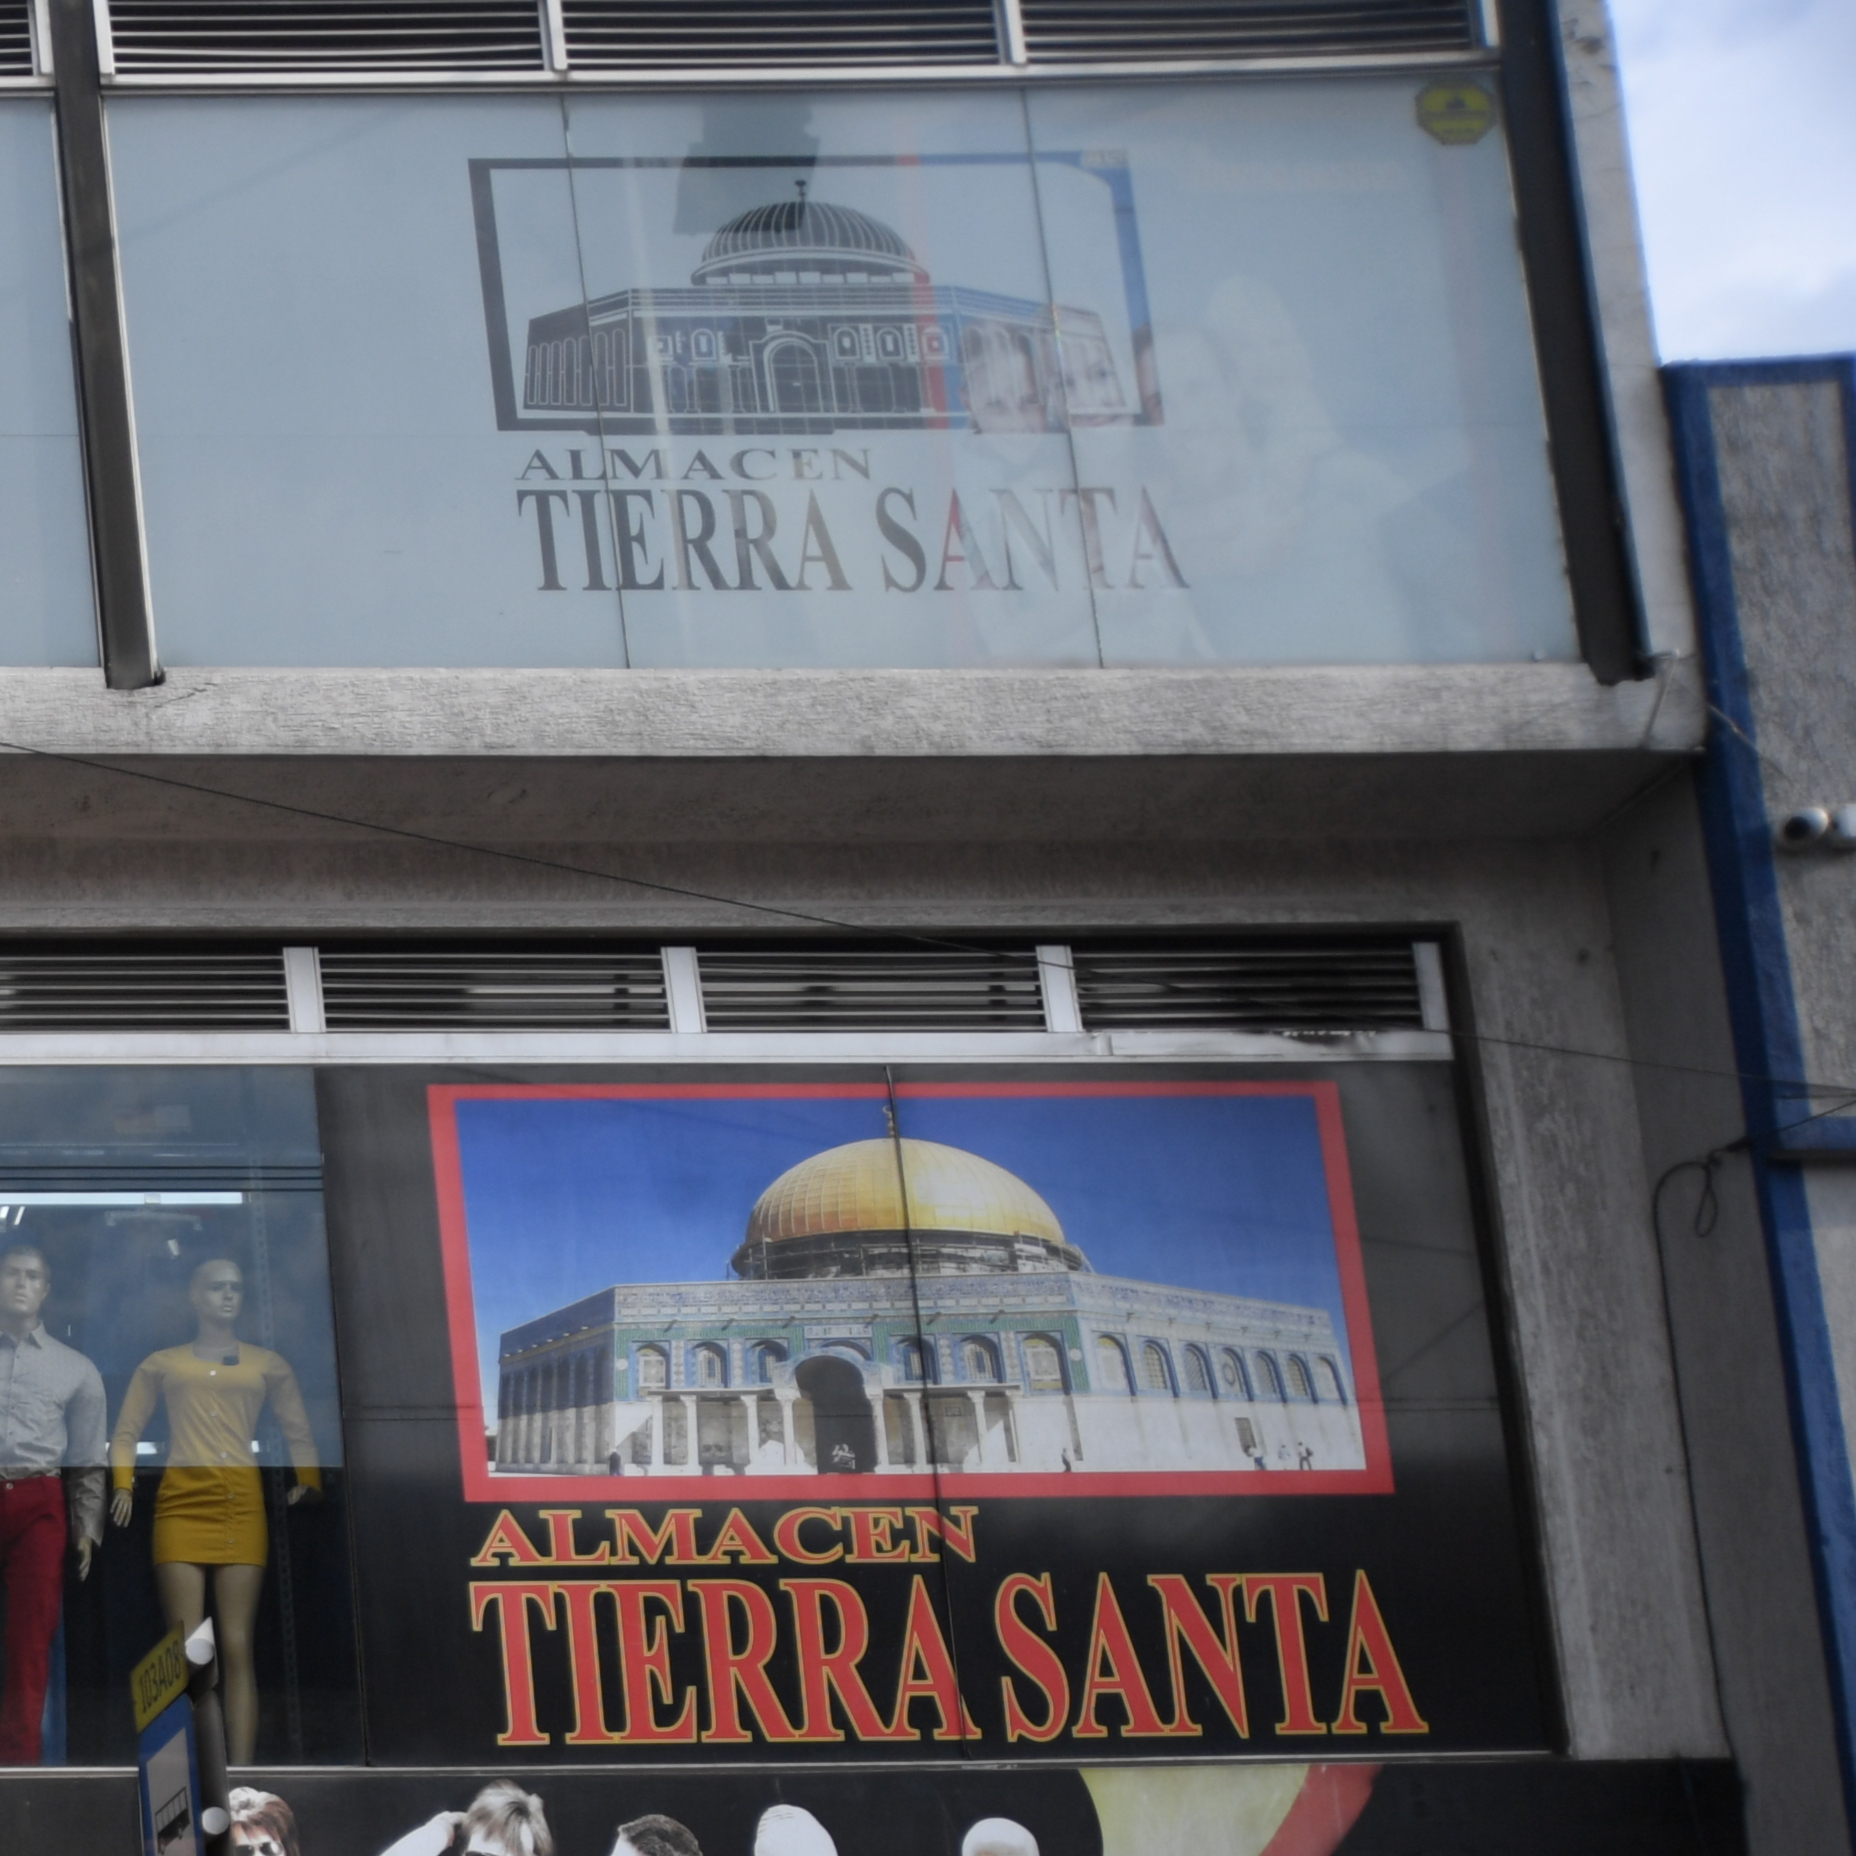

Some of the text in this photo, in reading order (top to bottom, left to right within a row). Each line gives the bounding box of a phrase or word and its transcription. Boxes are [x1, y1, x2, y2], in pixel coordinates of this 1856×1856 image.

[516, 447, 871, 481] ALMACEN
[516, 485, 1190, 593] TIERRA SANTA
[471, 1505, 978, 1566] ALMACEN
[471, 1568, 1430, 1747] TIERRA SANTA
